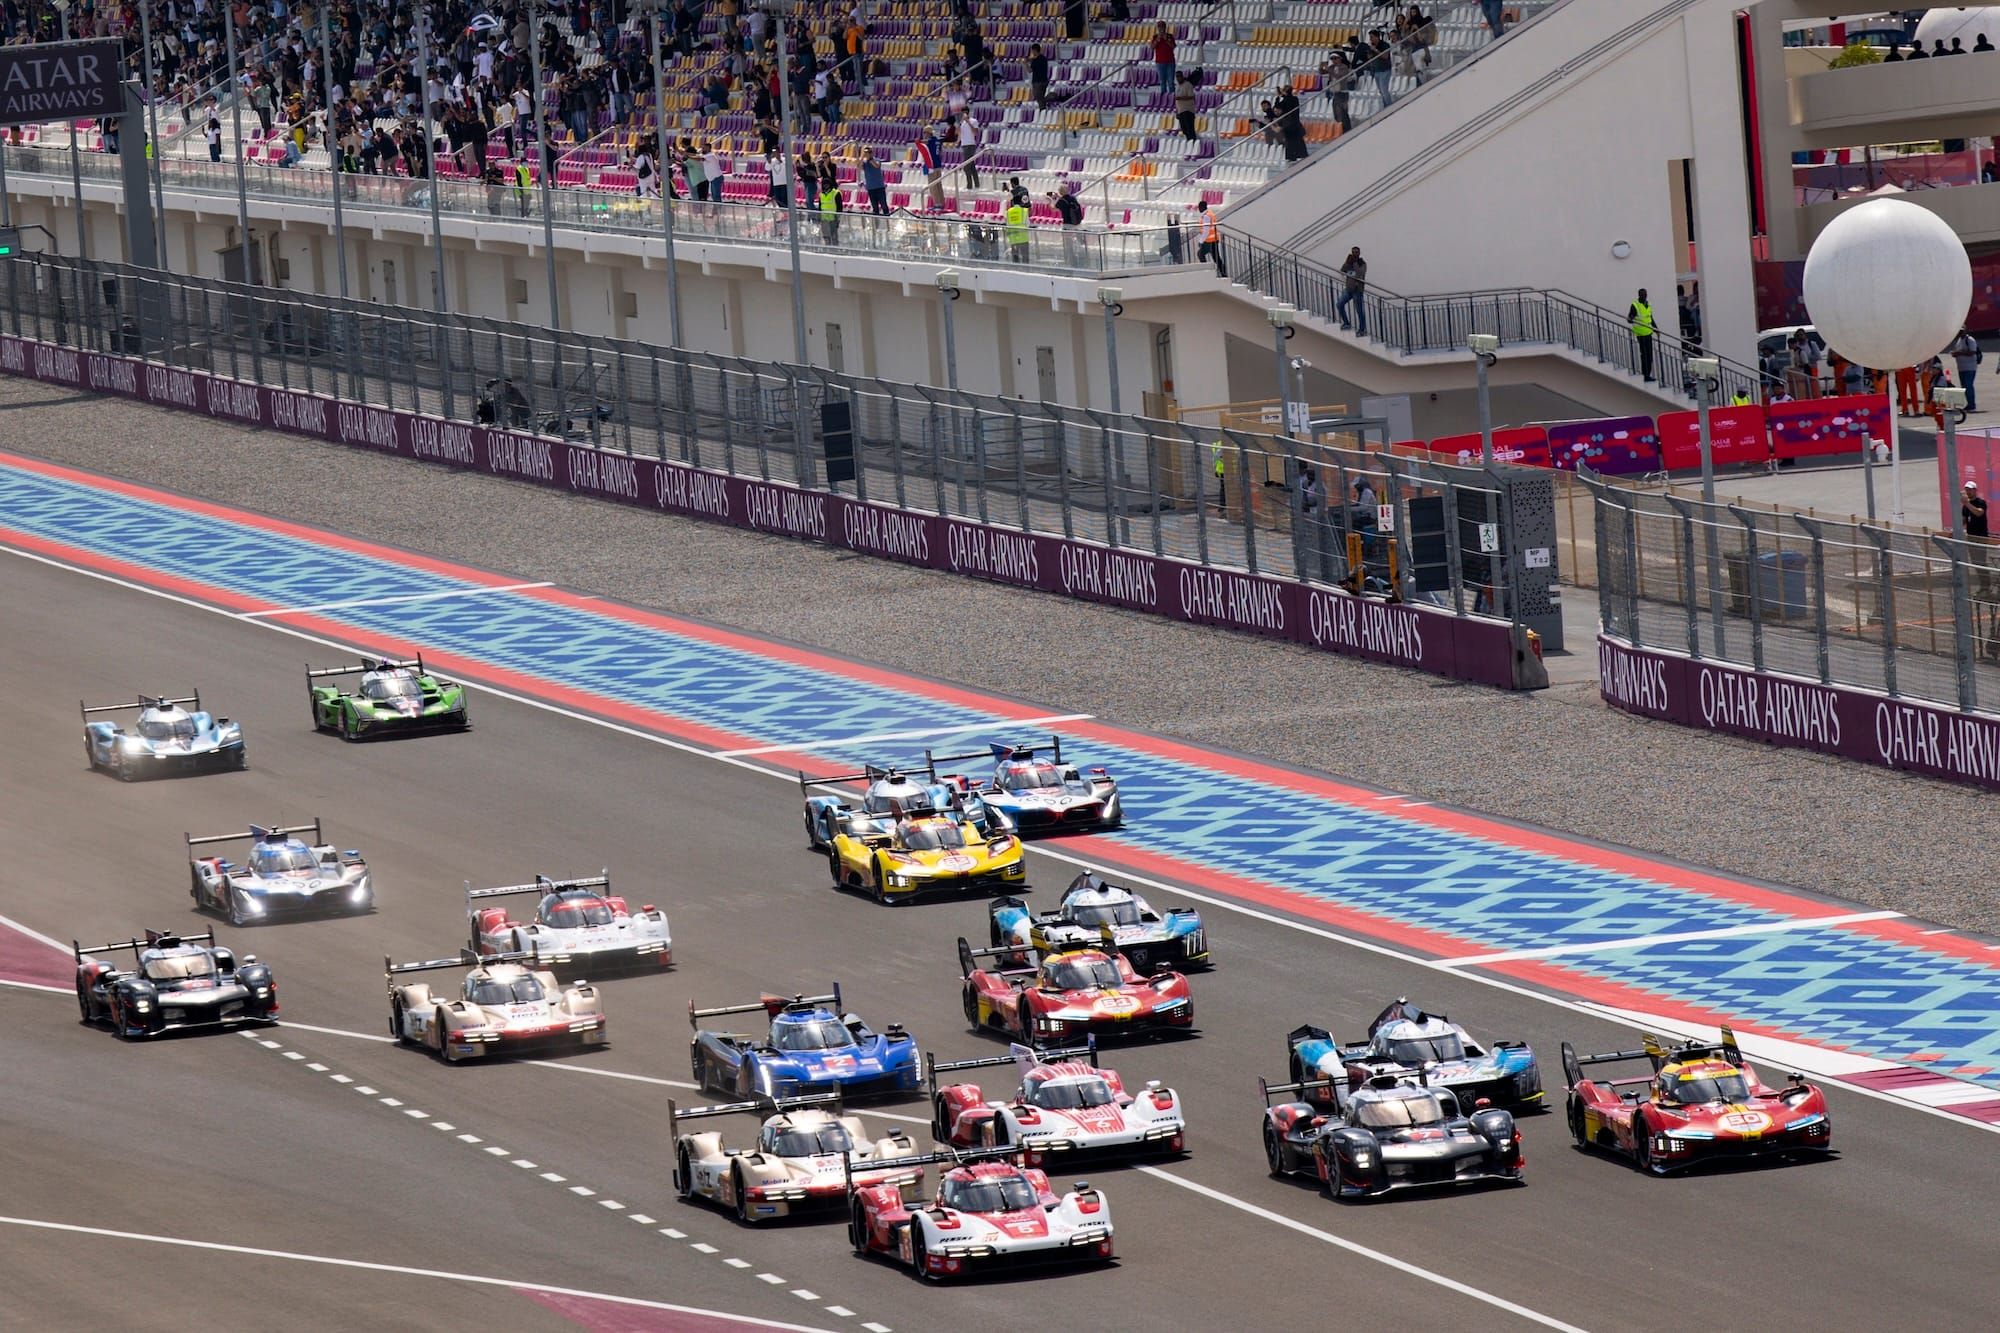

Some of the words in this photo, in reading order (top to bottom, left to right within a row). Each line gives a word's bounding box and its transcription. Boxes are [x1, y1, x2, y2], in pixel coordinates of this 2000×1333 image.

[4, 55, 102, 91] ATAR
[6, 88, 104, 113] AIRWAYS
[146, 365, 169, 400] QATAR
[206, 378, 231, 415] QATAR
[231, 382, 261, 420] AIRWAYS
[271, 391, 296, 425] QATAR
[297, 396, 327, 434] AIRWAYS
[338, 404, 364, 442] QATAR
[366, 409, 398, 449] AIRWAYS
[410, 418, 437, 457] QATAR
[440, 423, 475, 464] AIRWAYS
[487, 431, 516, 472] QATAR
[518, 437, 554, 480] AIRWAYS
[568, 449, 599, 489] QATAR
[601, 455, 638, 499] AIRWAYS
[654, 465, 687, 507] QATAR
[689, 472, 729, 517] AIRWAYS
[746, 484, 781, 527] QATAR
[782, 490, 825, 537] AIRWAYS
[843, 503, 880, 549] QATAR
[882, 510, 929, 561] AIRWAYS
[948, 523, 988, 571] QATAR
[990, 531, 1039, 583] AIRWAYS
[1060, 544, 1102, 595] QATAR
[1104, 552, 1157, 606] AIRWAYS
[1179, 568, 1226, 620] QATAR
[1227, 575, 1285, 631] AIRWAYS
[1309, 592, 1359, 645] QATAR
[1361, 601, 1423, 662] AIRWAYS
[1614, 647, 1668, 711] AIRWAYS
[1700, 669, 1761, 728] QATAR
[1764, 679, 1841, 746] AIRWAYS
[1876, 702, 1943, 765] QATAR
[1947, 716, 2000, 781] AIRW
[1727, 1113, 1762, 1126] 50
